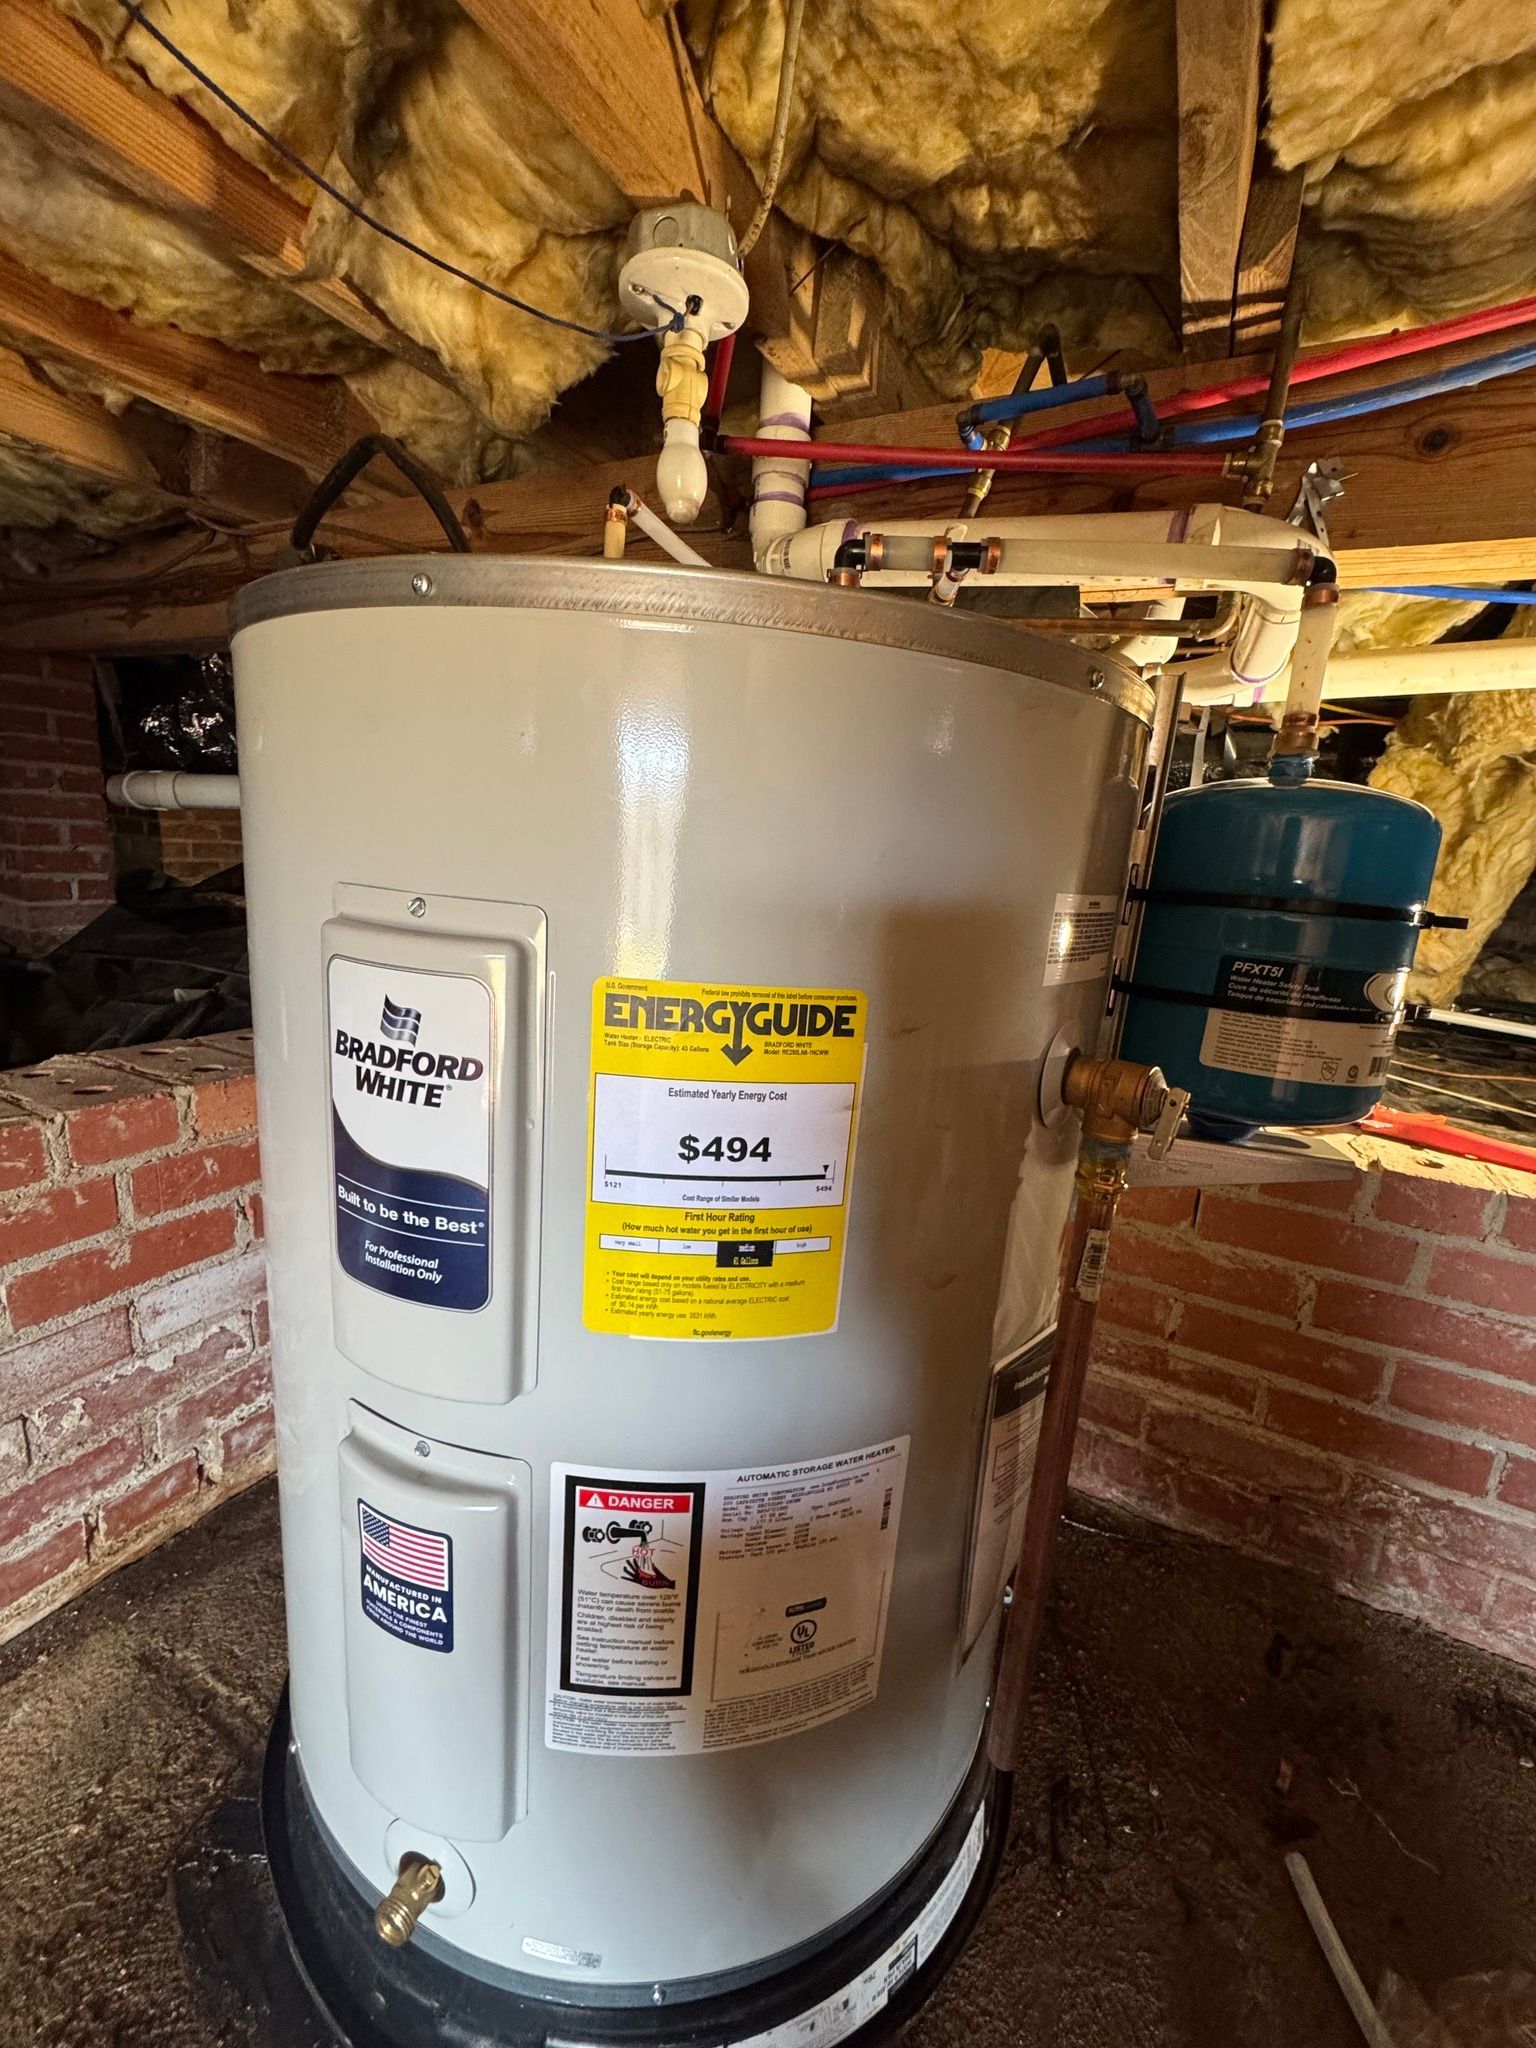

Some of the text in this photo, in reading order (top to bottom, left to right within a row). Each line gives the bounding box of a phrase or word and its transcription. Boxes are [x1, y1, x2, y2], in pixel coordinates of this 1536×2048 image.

[618, 983, 648, 991] Government
[1252, 977, 1277, 986] Heater
[1303, 984, 1320, 992] Tank
[605, 992, 857, 1038] ENERGYGUIDE
[630, 1041, 653, 1049] (Storage
[644, 1035, 672, 1043] ELECTRIC
[335, 1029, 484, 1082] BRADFORD
[668, 1087, 788, 1103] Estimated Yearly Energy Cost
[678, 1134, 772, 1164] $494
[604, 1181, 622, 1189] $121
[338, 1184, 361, 1207] Built
[362, 1199, 376, 1213] to
[380, 1203, 398, 1221] be
[402, 1211, 430, 1228] the
[696, 1194, 713, 1203] Range
[714, 1194, 721, 1202] of
[721, 1194, 740, 1202] Similar
[685, 1212, 755, 1223] First Hour Rating
[622, 1222, 641, 1231] (How
[643, 1224, 664, 1232] much
[666, 1225, 678, 1233] hot
[718, 1227, 730, 1236] get
[741, 1227, 752, 1235] the
[754, 1226, 768, 1235] first
[770, 1226, 787, 1234] hour
[788, 1225, 796, 1233] of
[797, 1225, 812, 1234] use)
[364, 1240, 439, 1270] For Professional
[365, 1252, 443, 1285] Installation Only
[651, 1273, 671, 1281] depend
[749, 1296, 777, 1304] ELECTRIC
[736, 1445, 896, 1482] AUTOMATIC STORAGE WATER HEATER
[608, 1495, 674, 1509] DANGER
[632, 1547, 656, 1557] HOT
[366, 1563, 442, 1604] MANUFACTURED IN
[363, 1573, 448, 1624] AMERICA
[599, 1591, 640, 1600] temperature
[366, 1598, 393, 1622] MATERIALS
[399, 1620, 443, 1639] COMPONENTS
[375, 1600, 428, 1628] USING THE FINEST
[366, 1605, 444, 1646] FROM AROUND THE WORLD
